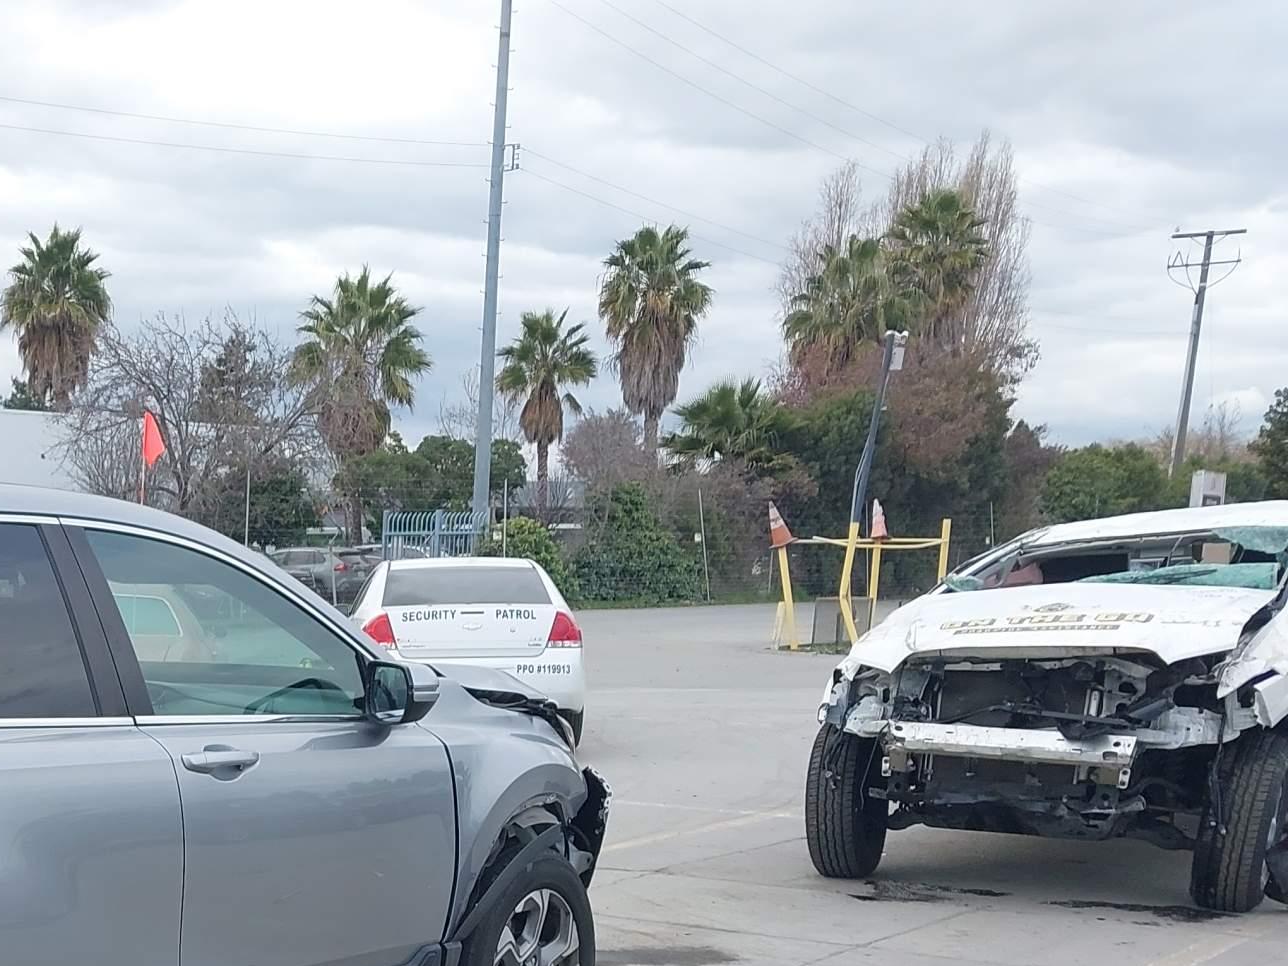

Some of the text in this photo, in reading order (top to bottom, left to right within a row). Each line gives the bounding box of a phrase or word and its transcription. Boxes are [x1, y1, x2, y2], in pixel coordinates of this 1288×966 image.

[401, 608, 537, 623] SECURITY PATROL
[516, 664, 571, 674] PPO #119913
